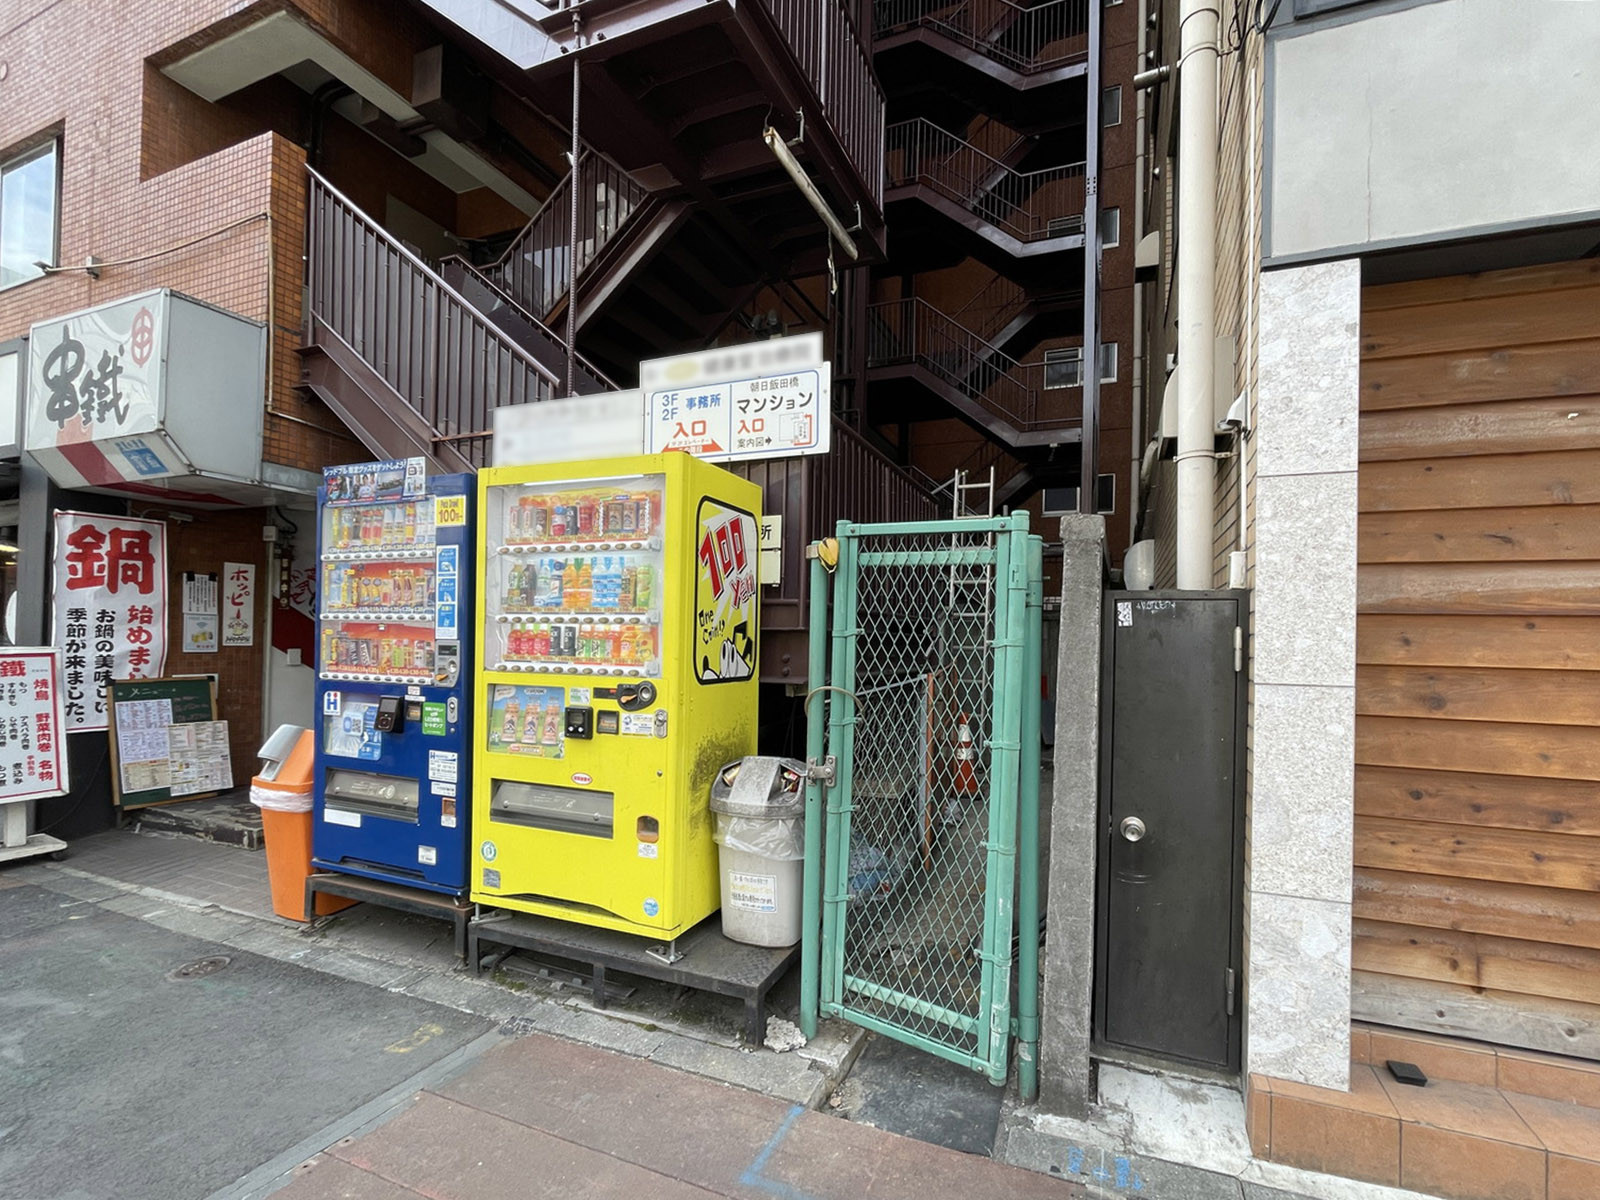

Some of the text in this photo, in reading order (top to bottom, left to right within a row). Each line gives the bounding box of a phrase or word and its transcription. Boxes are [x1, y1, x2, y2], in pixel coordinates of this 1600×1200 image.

[749, 377, 800, 393] 朝日飯田橋
[662, 393, 721, 410] 3F 事務所
[737, 391, 813, 414] マンション
[662, 407, 678, 421] 2F
[673, 420, 707, 439] 入口
[737, 418, 765, 434] 入口
[737, 437, 765, 449] 案内図
[65, 524, 156, 595] 鍋
[699, 515, 748, 602] 100
[226, 567, 250, 619] ホッピー
[65, 608, 87, 724] 季節が来ました。
